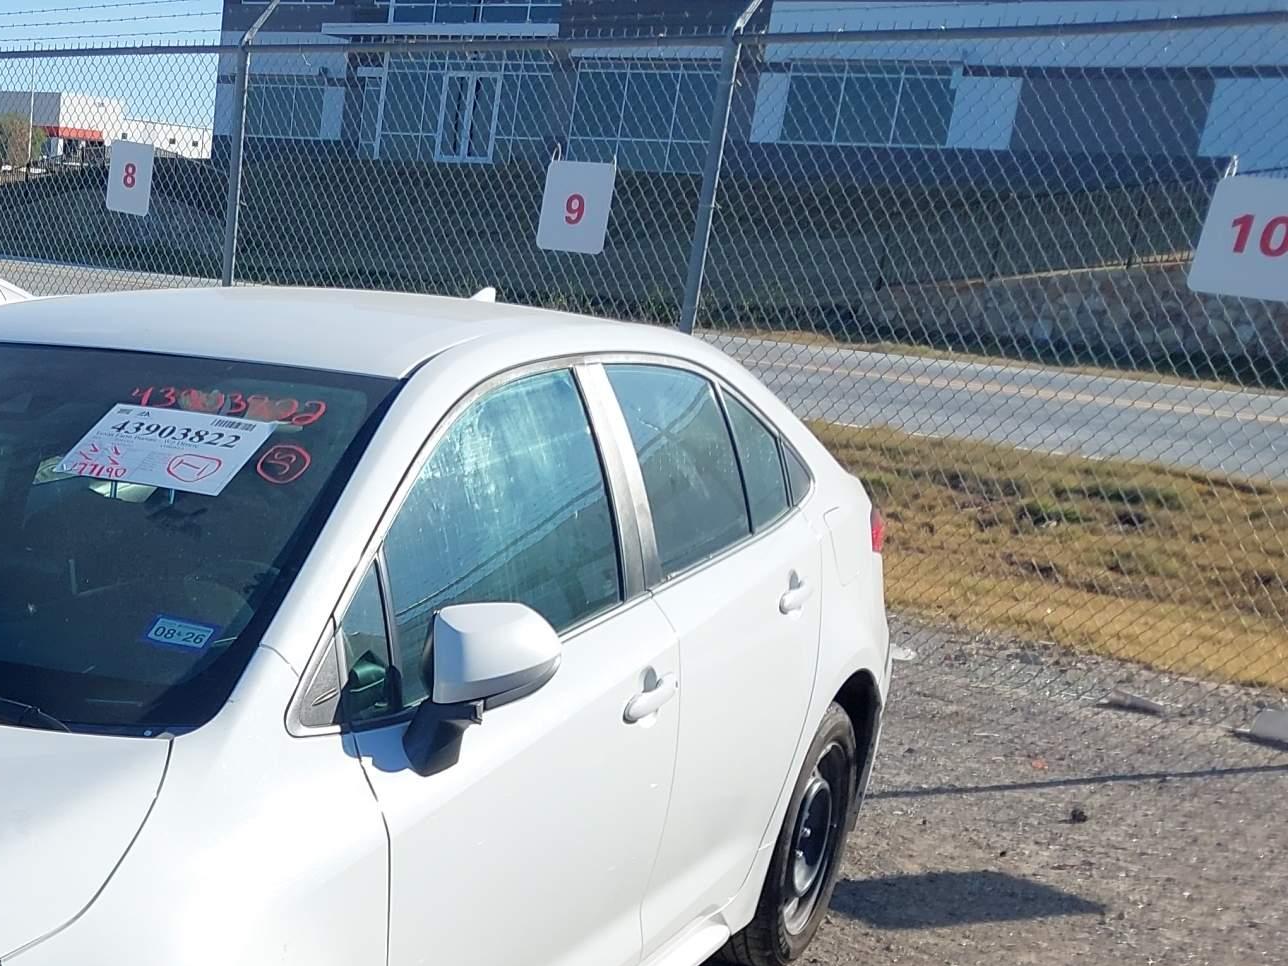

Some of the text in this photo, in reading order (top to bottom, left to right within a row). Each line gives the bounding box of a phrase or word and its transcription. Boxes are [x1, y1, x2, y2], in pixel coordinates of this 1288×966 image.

[123, 163, 136, 188] 8
[565, 193, 585, 225] 9
[1231, 213, 1288, 257] 10
[112, 420, 241, 448] 43903822
[154, 626, 176, 639] 08
[182, 632, 206, 644] 26
